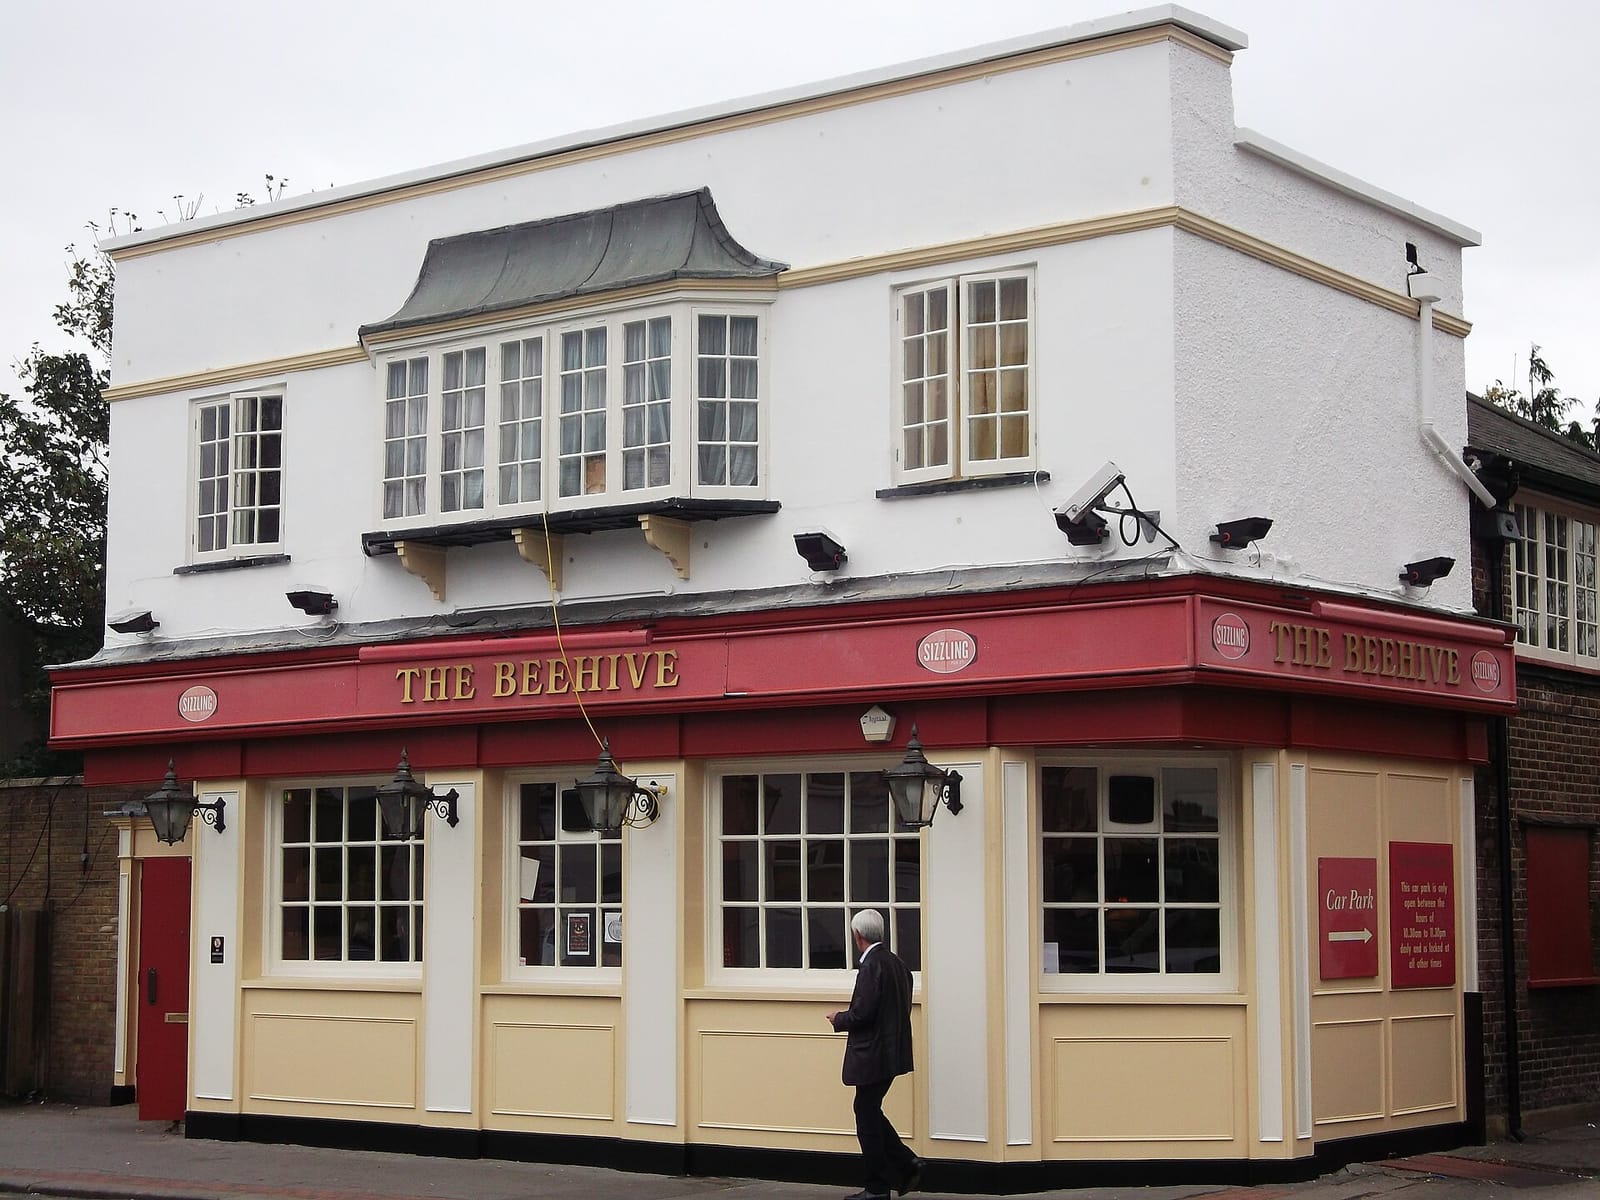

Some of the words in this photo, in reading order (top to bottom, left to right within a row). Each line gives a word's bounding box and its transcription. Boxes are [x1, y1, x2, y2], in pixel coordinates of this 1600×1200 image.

[1216, 624, 1245, 648] SIZZLING
[923, 640, 969, 662] SIZZLING
[1269, 619, 1332, 669] THE
[1343, 632, 1461, 685] BEEHIVE
[395, 664, 476, 703] THE
[492, 649, 680, 697] BEEHIVE
[1474, 661, 1497, 681] SIZZLING
[182, 695, 213, 712] SIZZLING
[1400, 881, 1410, 893] This
[1411, 885, 1419, 893] car
[1420, 881, 1431, 895] park
[1432, 882, 1437, 893] is
[1438, 881, 1448, 895] only
[1326, 889, 1348, 911] Car
[1349, 888, 1374, 910] Park
[1404, 899, 1416, 909] open
[1417, 897, 1436, 908] between
[1437, 897, 1445, 908] the
[1415, 911, 1428, 923] hours
[1429, 911, 1435, 923] of
[1423, 929, 1428, 938] to
[1400, 942, 1411, 956] daily
[1413, 942, 1422, 953] and
[1429, 942, 1443, 953] locked
[1444, 943, 1450, 953] at
[1416, 957, 1429, 969] other
[1430, 957, 1442, 968] times
